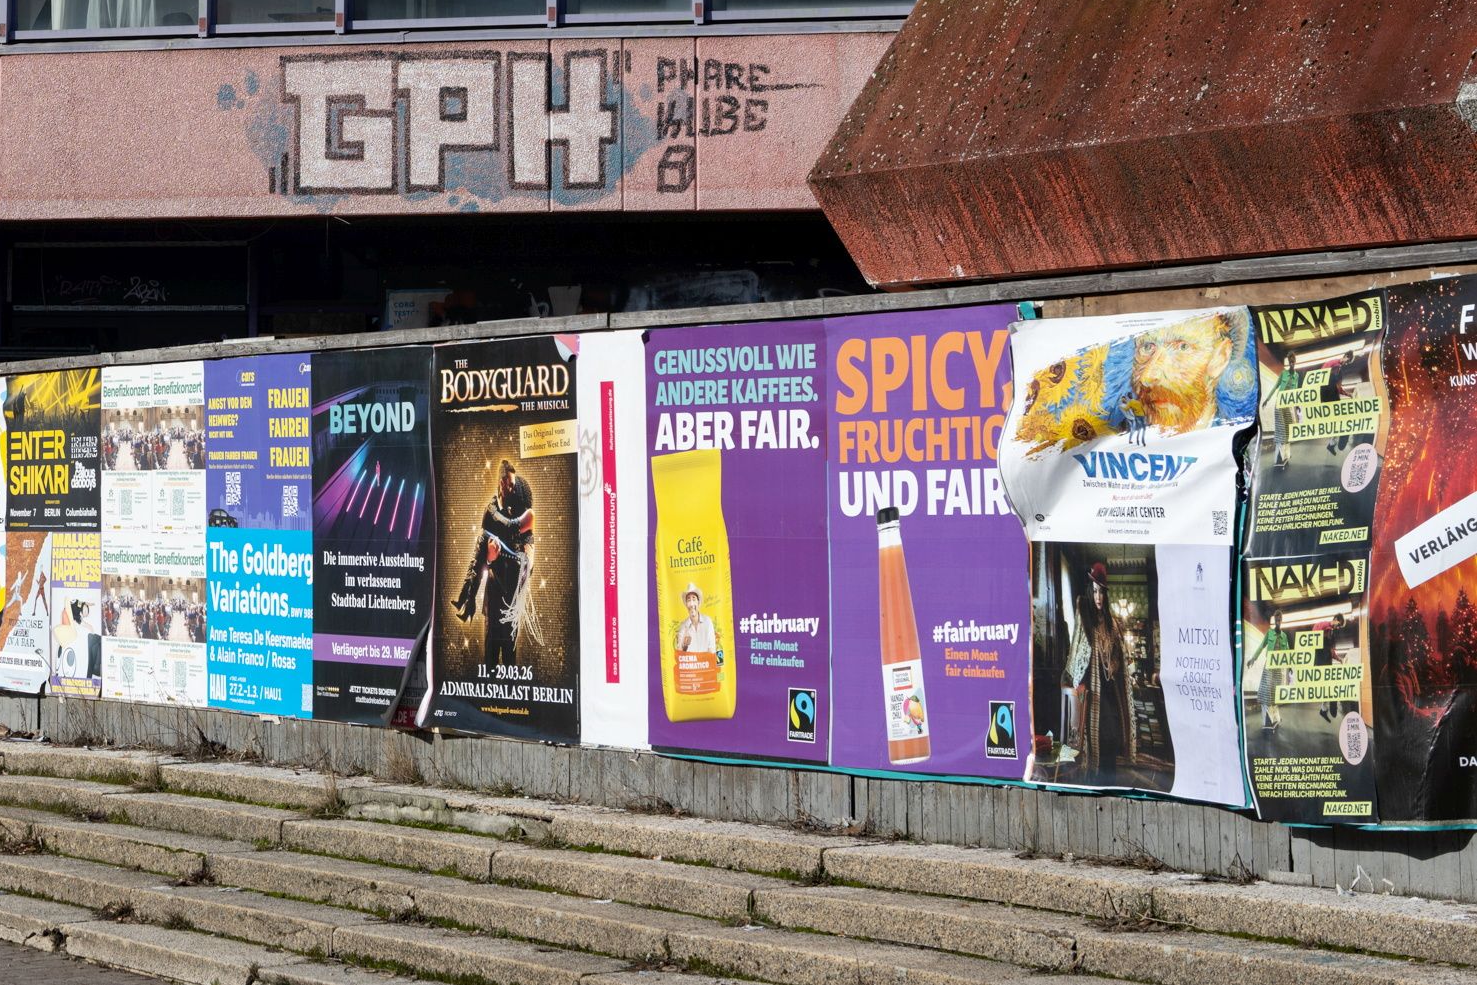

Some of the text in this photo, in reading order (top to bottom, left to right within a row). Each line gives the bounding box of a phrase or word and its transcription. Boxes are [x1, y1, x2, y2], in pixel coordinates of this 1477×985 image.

[1262, 299, 1373, 344] NAKED
[1459, 303, 1476, 335] F
[454, 359, 469, 369] THE
[654, 343, 817, 376] GENUSSVOLL WIE
[440, 364, 569, 404] BODYGUARD
[1306, 370, 1328, 385] GET
[103, 384, 151, 398] Benefizkonzert
[153, 381, 202, 396] Benefizkonzert
[655, 376, 818, 406] ANDERE KAFFEES.
[1279, 389, 1318, 405] NAKED
[268, 387, 310, 409] FRAUEN
[520, 399, 570, 411] THE MUSICAL
[329, 400, 416, 434] BEYOND
[1305, 399, 1379, 419] UND BEENDE
[269, 417, 309, 438] FAHREN
[523, 427, 566, 440] Das Original vom
[654, 409, 820, 451] ABER FAIR.
[1292, 418, 1374, 438] DEN BULLSHIT.
[10, 429, 66, 461] ENTER
[523, 438, 571, 452] Londoner West End
[270, 447, 310, 468] FRAUEN
[1073, 451, 1199, 482] VINCENT
[9, 464, 69, 496] SHIKARI
[839, 469, 916, 517] UND
[9, 508, 32, 517] November
[44, 508, 61, 517] BERLIN
[65, 507, 98, 517] Columbiahalle
[1096, 507, 1166, 518] NEW MEDIA ART CENTER
[609, 492, 617, 586] Kulturplakatierung
[1323, 528, 1366, 541] NAKED.NET
[677, 536, 703, 554] Café
[209, 540, 313, 586] The Goldberg
[323, 550, 424, 572] Die immersive Ausstellung
[669, 551, 716, 569] Intención
[52, 559, 101, 582] HAPPINESS
[344, 573, 402, 590] im verlassenen
[331, 592, 416, 615] Stadtbad Lichtenberg
[739, 613, 820, 637] #fairbruary
[932, 619, 1020, 645] #fairbruary
[209, 625, 264, 645] Anne Teresa De
[1178, 628, 1219, 646] MITSKI
[331, 641, 392, 659] Verlängert bis 29.
[750, 638, 799, 652] Einen Monat
[217, 645, 296, 670] Alain Franco Rosas
[750, 654, 805, 668] fair einkaufen
[944, 648, 999, 662] Einen Monat
[1175, 656, 1221, 671] NOTHING'S
[945, 665, 1006, 679] fair einkaufen
[1182, 672, 1212, 684] ABOUT
[209, 673, 227, 701] HAU
[264, 686, 283, 701] HAU1
[439, 680, 574, 704] ADMIRALSPALAST BERLIN
[1176, 684, 1222, 699] TO HAPPEN
[1190, 698, 1215, 713] TO ME
[789, 730, 814, 740] FAIRTRADE
[987, 746, 1016, 756] FAIRTRADE
[1325, 804, 1369, 814] NAKED.NET
